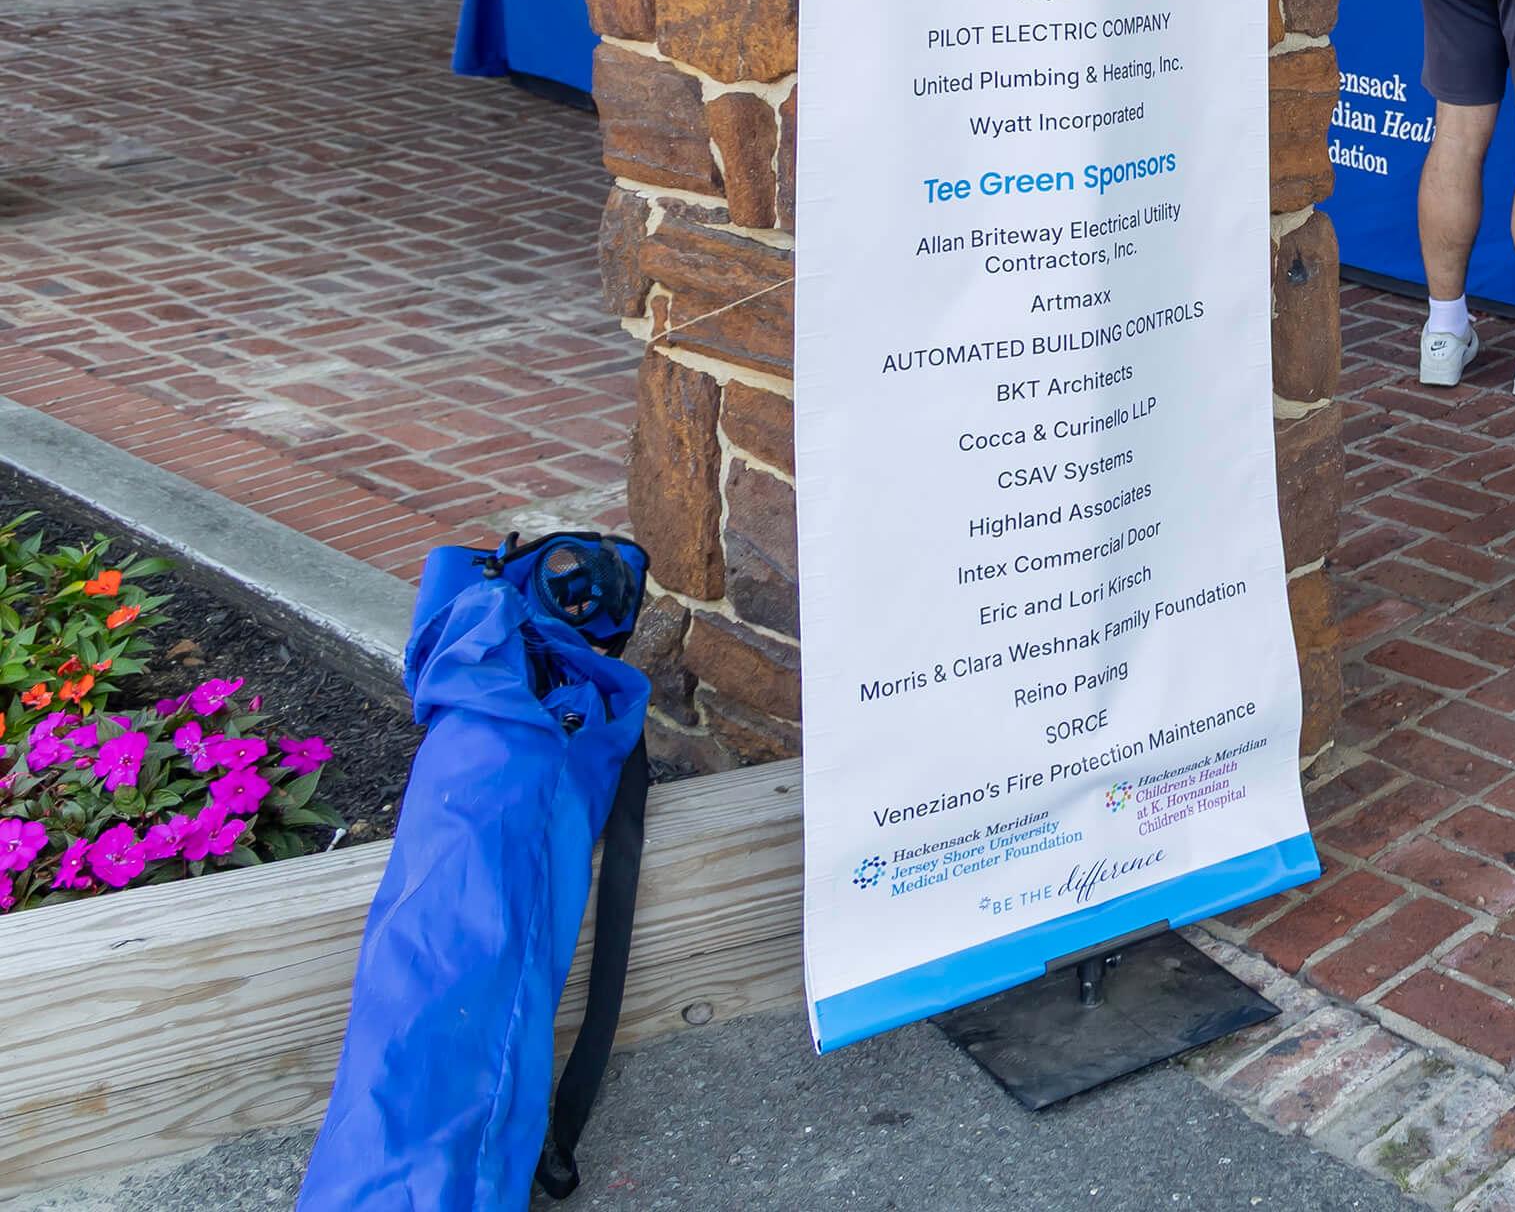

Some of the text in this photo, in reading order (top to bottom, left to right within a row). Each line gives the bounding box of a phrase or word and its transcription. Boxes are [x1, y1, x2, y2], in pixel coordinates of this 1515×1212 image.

[928, 11, 1172, 49] PILOT ELECTRIC COMPANY
[969, 101, 1144, 139] Wyatt Incorporated
[913, 61, 1156, 261] United Plumbing & Heating, Inc.
[923, 152, 1177, 205] Tee Green Sponsors
[1328, 139, 1388, 175] dation
[915, 203, 1181, 256] Allan Briteway Electrical Utility
[984, 242, 1134, 274] Contractors, Inc.
[1030, 289, 1112, 314] Artmaxx
[881, 300, 1205, 374] AUTOMATED BUILDING CONTROLS
[996, 364, 1133, 403] BKT Architects
[958, 396, 1157, 452] Cocca & Curinello LLP
[997, 449, 1134, 489] CSAV Systems
[969, 483, 1152, 539] Highland Associates
[958, 521, 1162, 585] Intex Commercial Door
[979, 565, 1152, 626] Eric and Lori Kirsch
[860, 581, 1247, 703] Morris & Clara Weshnak Family Foundation
[1014, 661, 1129, 708] Reino Paving
[1045, 708, 1109, 745] SORCE
[873, 701, 1260, 828] Veneziano's Fire Protection Maintenance
[1136, 760, 1239, 803] Children's Health
[1137, 737, 1268, 786] Hackensack Meridian
[1136, 778, 1231, 821] at K. Hovnanian
[1138, 785, 1247, 837] Children's Hospital
[890, 829, 1083, 898] Medical Center Foundation
[891, 819, 1061, 881] Jersey Shore University
[892, 810, 1053, 865] Hackensack Meridian
[992, 849, 1165, 915] BE THE difference
